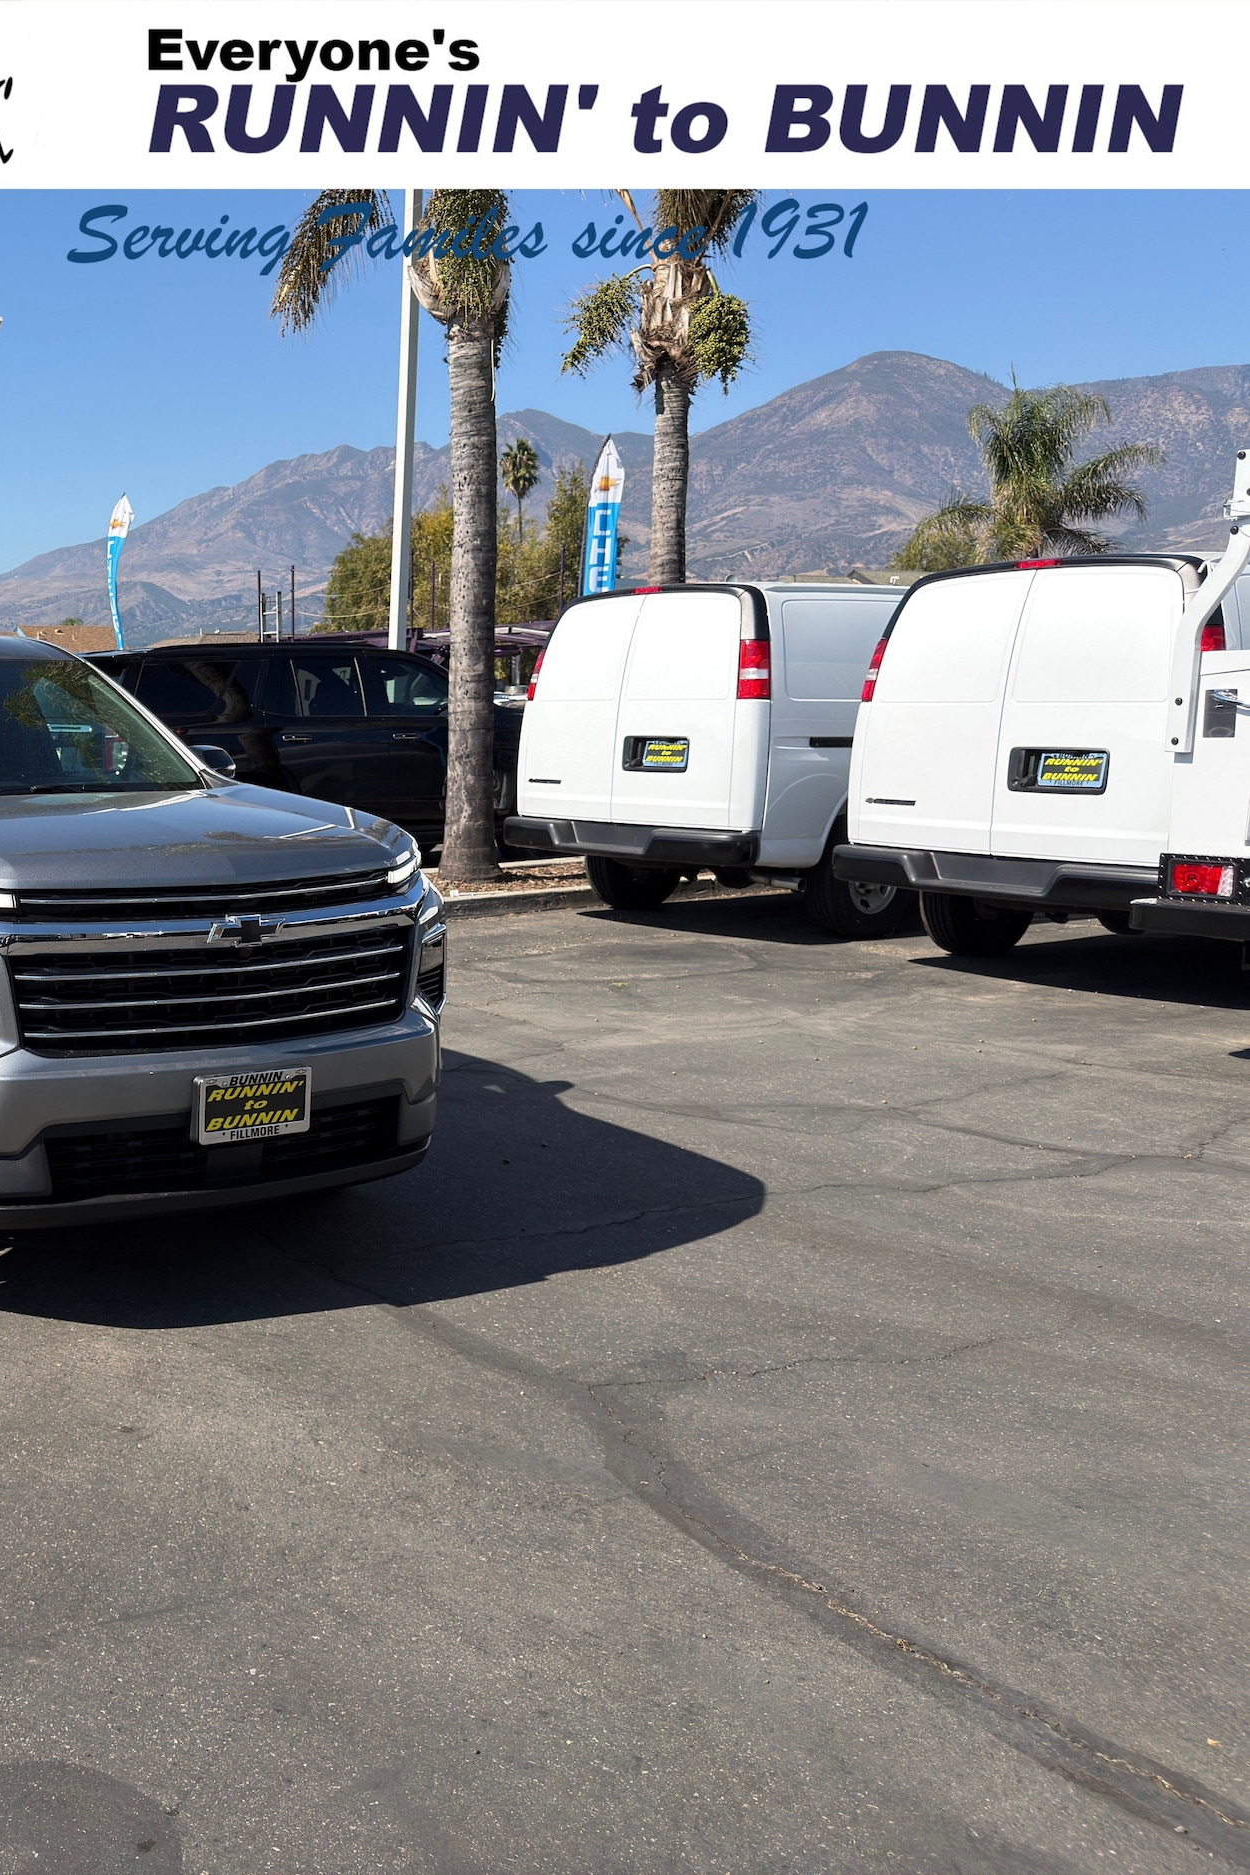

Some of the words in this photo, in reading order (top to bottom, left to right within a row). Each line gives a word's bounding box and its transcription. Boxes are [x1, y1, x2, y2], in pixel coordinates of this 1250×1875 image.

[1041, 772, 1099, 782] BUNNIN
[229, 1071, 284, 1087] BUNNIN
[207, 1080, 305, 1103] RUNNIN'
[244, 1099, 268, 1111] to
[205, 1108, 299, 1132] BUNNIN
[230, 1124, 280, 1141] FILLMORE
